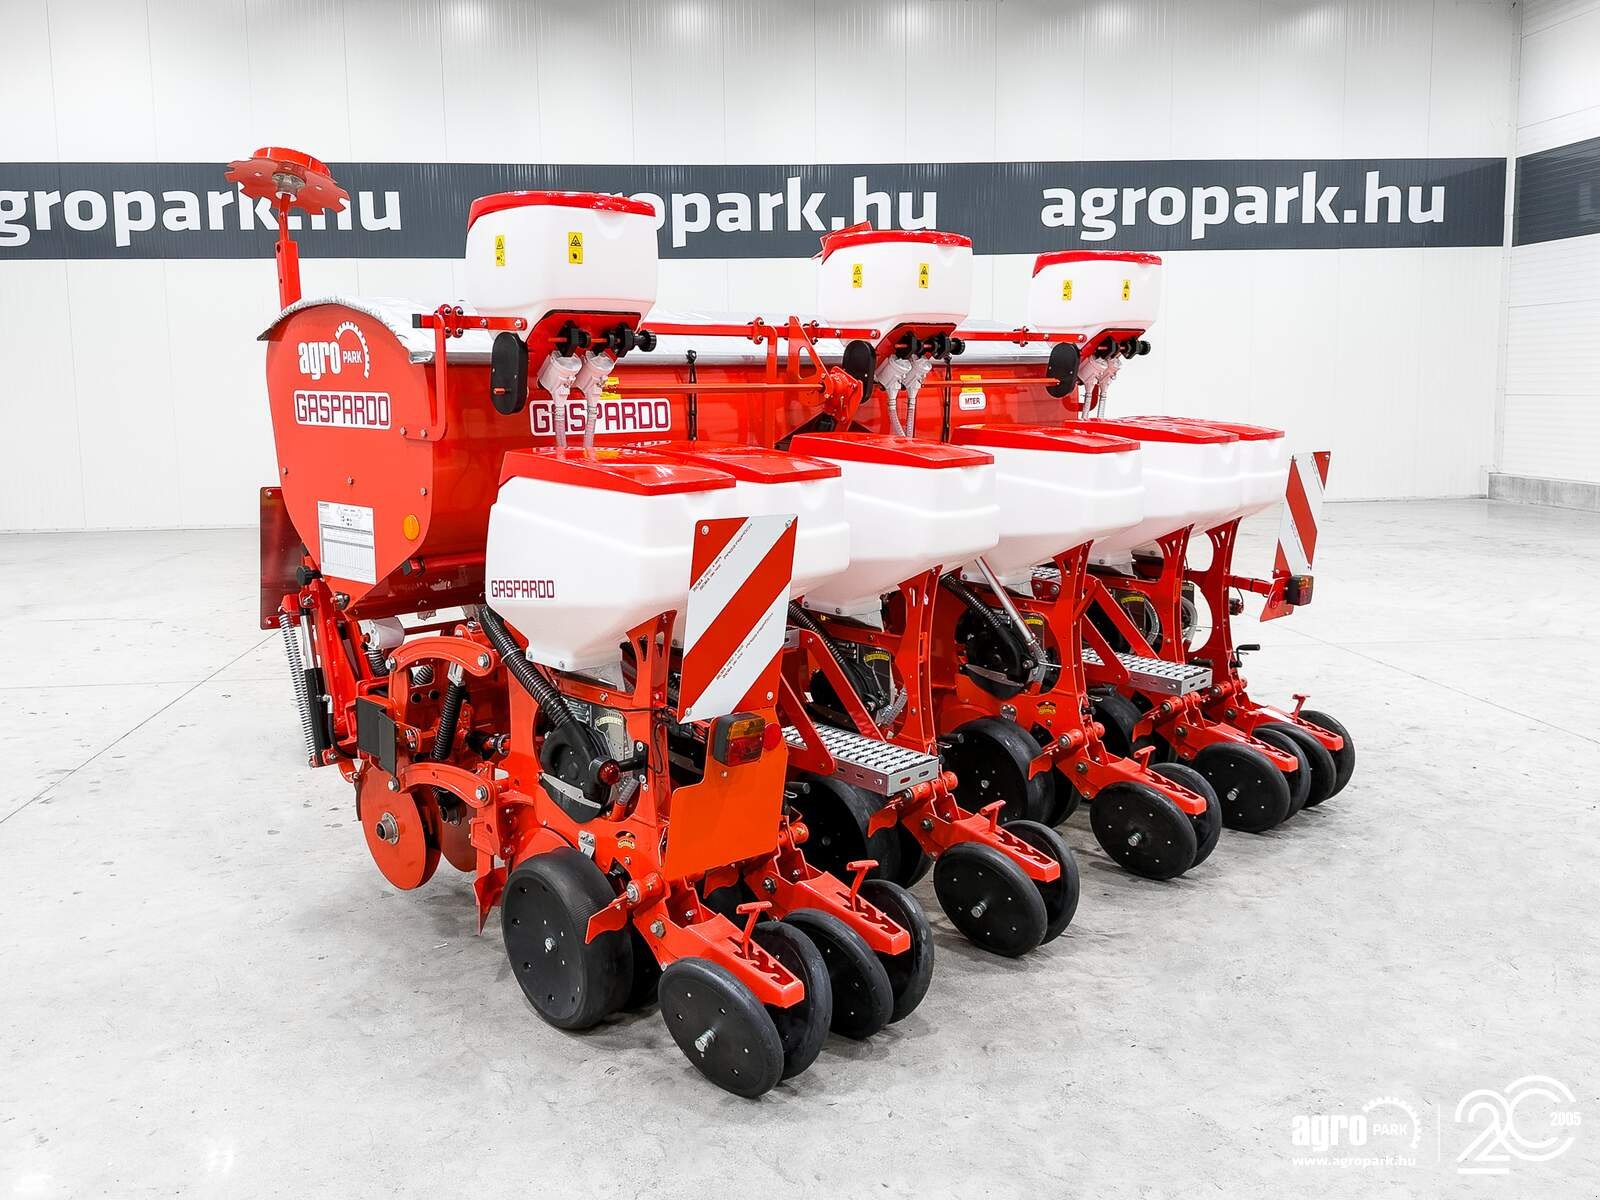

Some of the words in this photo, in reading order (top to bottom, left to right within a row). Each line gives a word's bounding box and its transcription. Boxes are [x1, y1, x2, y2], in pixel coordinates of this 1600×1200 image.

[1041, 171, 1446, 241] agropark.hu
[298, 341, 341, 380] agro
[342, 350, 363, 364] PARK
[296, 394, 390, 426] GASPARDO
[491, 579, 555, 599] GASPARDO
